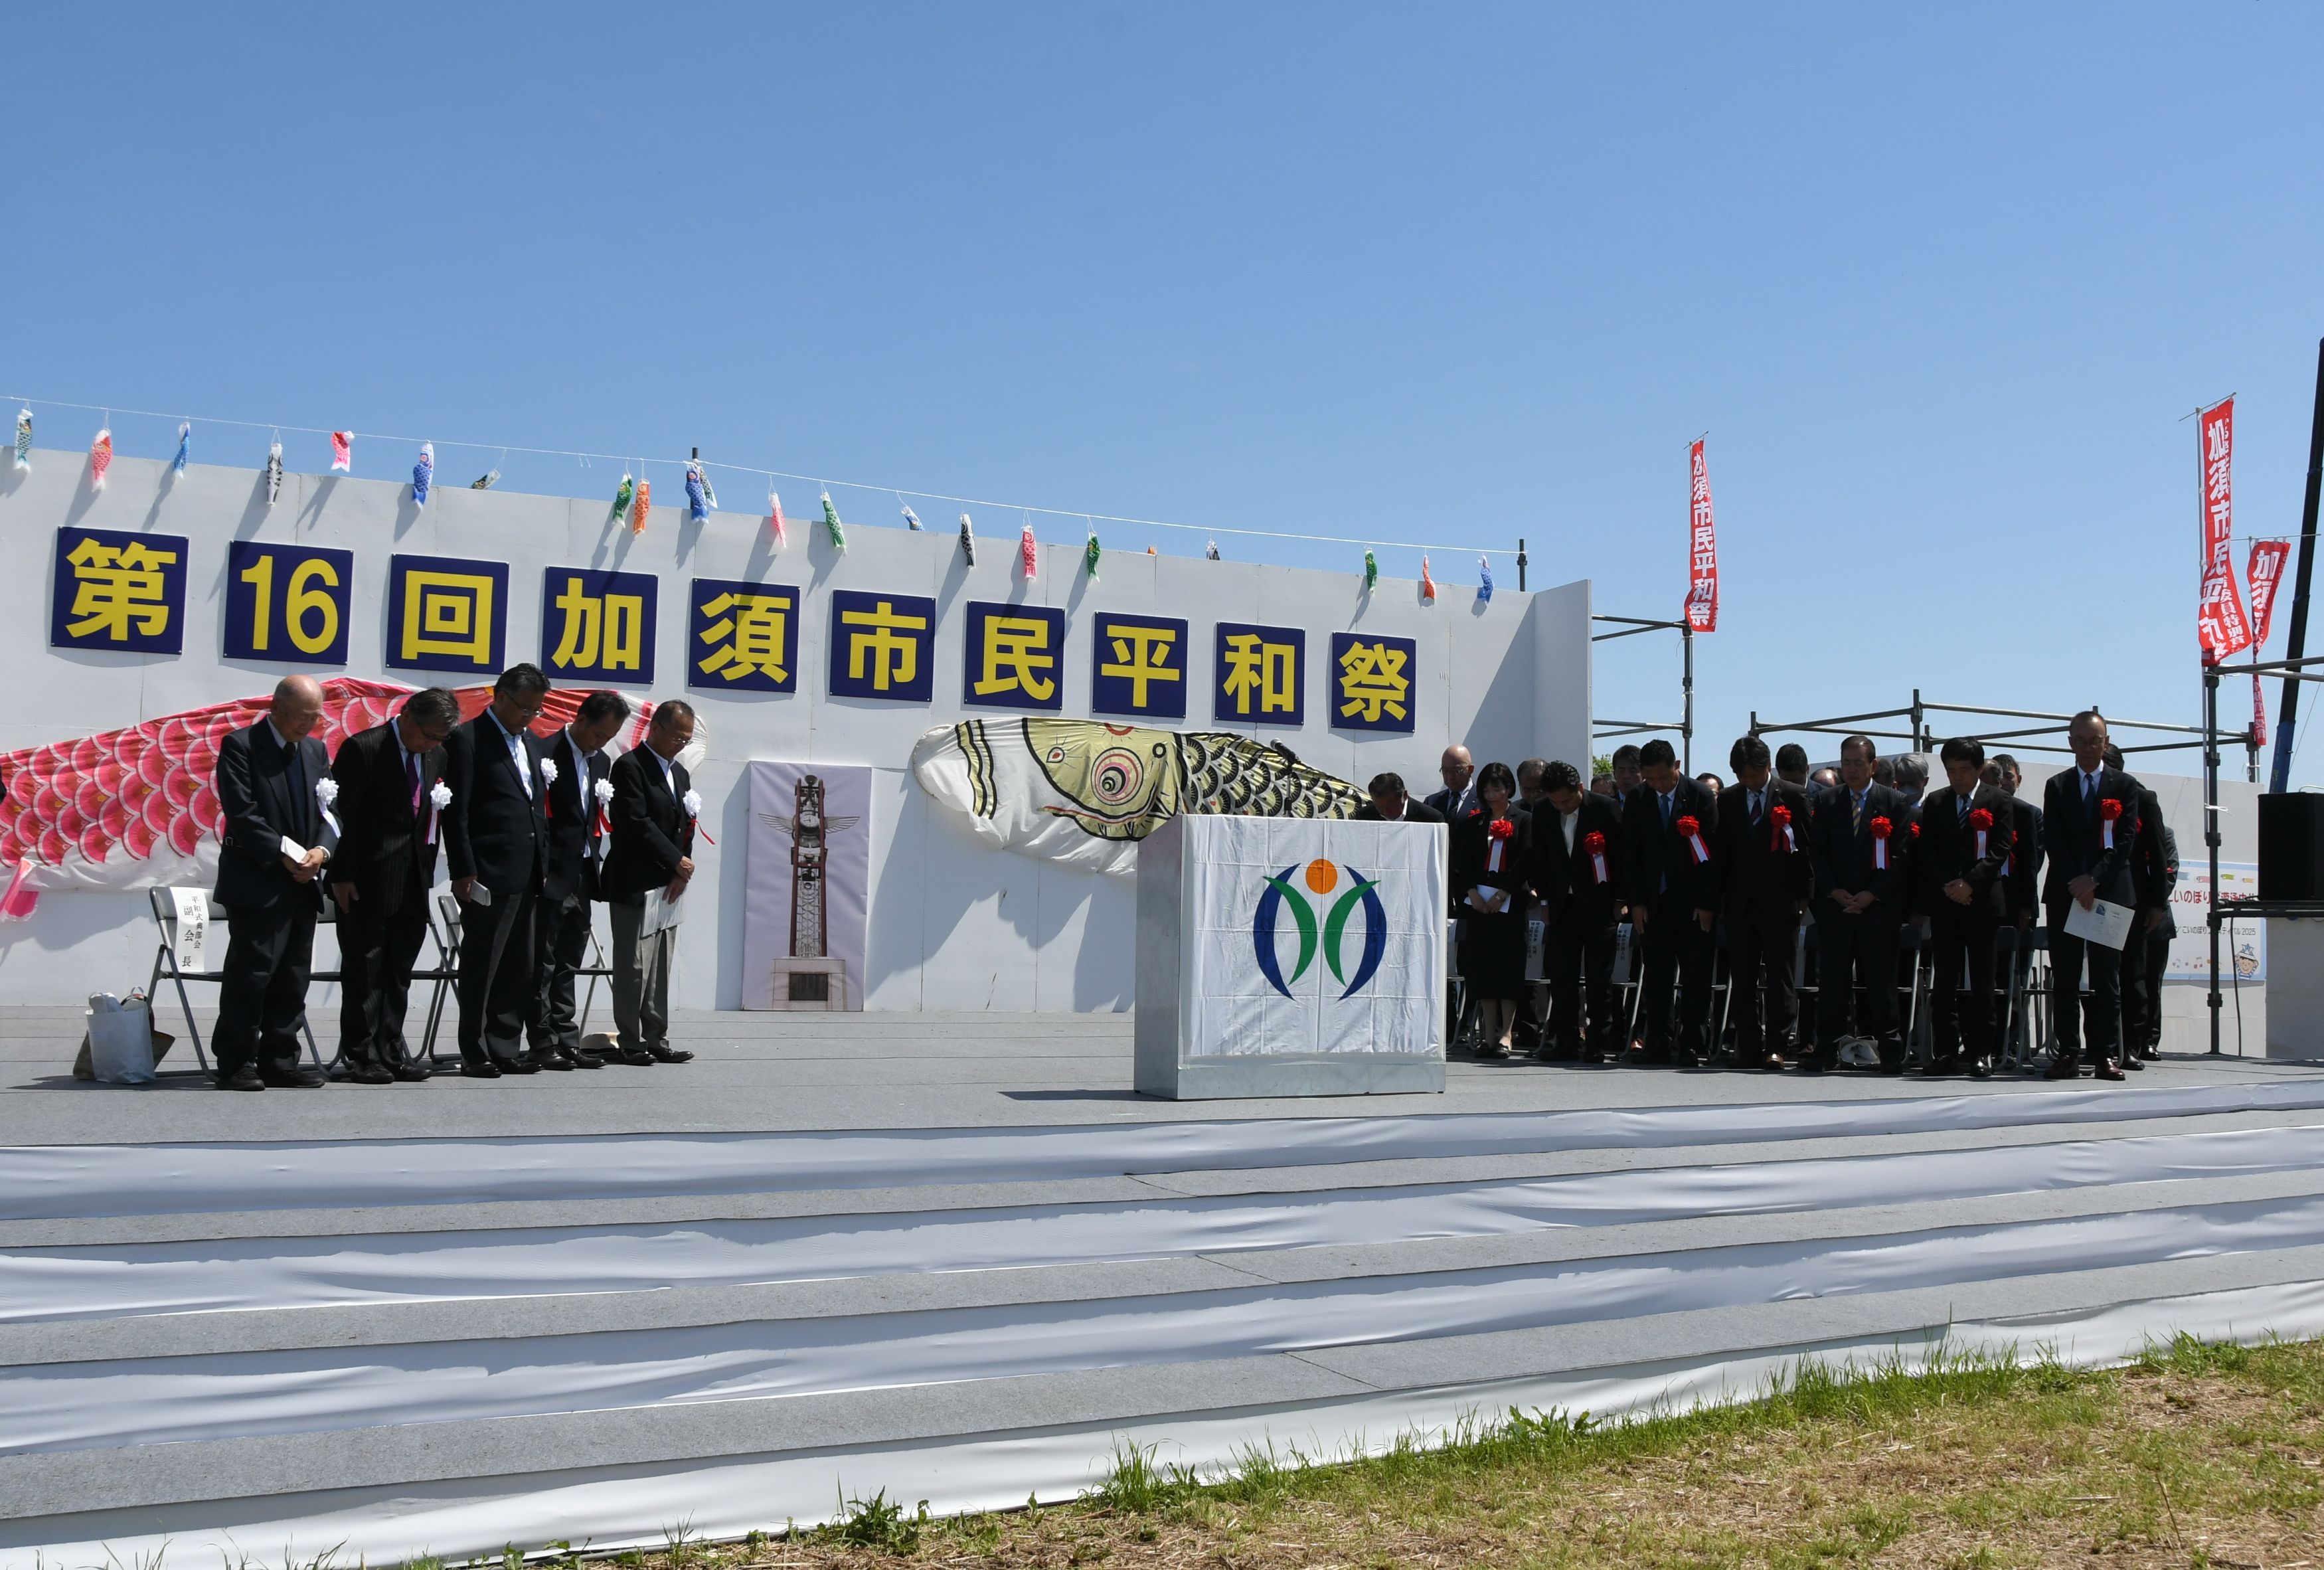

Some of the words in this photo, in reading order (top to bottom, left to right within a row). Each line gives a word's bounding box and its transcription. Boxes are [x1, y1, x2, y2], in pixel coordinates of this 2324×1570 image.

[66, 537, 1409, 722] 第16回加須市民平和祭
[181, 905, 195, 967] 副会長
